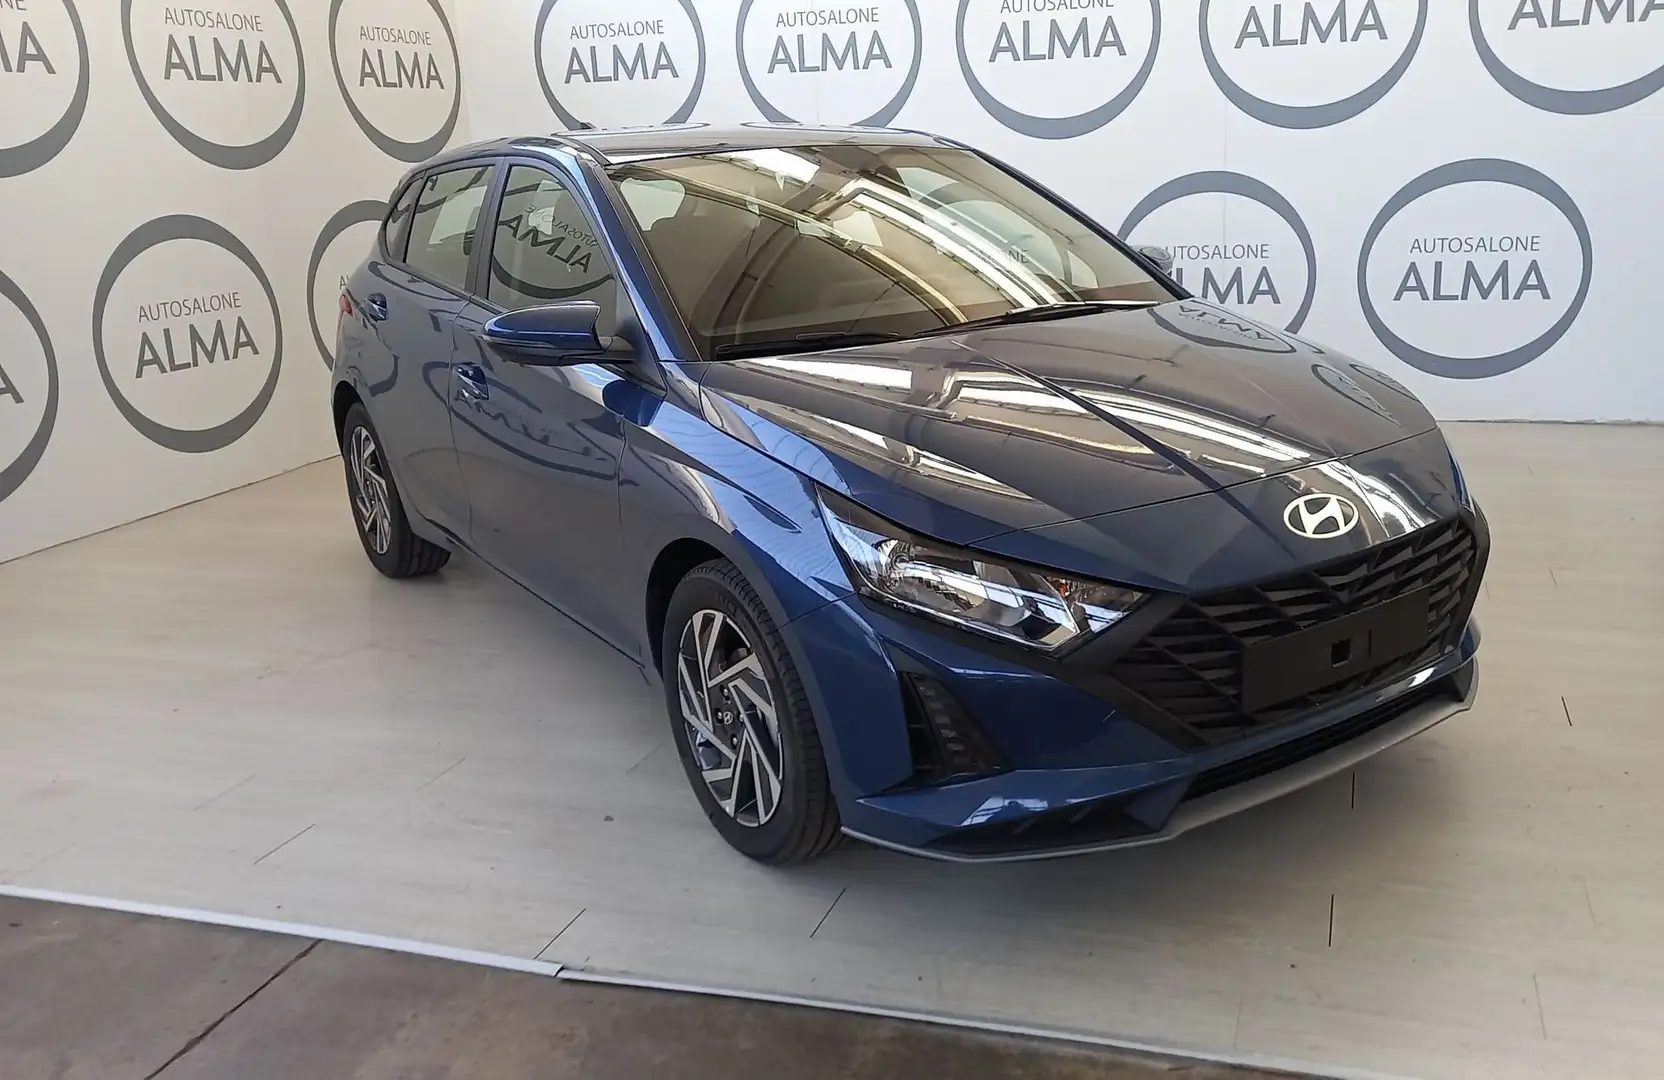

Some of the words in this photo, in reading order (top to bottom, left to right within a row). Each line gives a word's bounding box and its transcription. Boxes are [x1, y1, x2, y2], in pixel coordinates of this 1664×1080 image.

[164, 7, 264, 33] AUTOSALONE
[359, 25, 432, 46] AUTOSALONE
[569, 19, 665, 41] AUTOSALONE
[775, 6, 880, 28] AUTOSALONE
[1233, 0, 1389, 50] ALMA
[163, 33, 283, 84] ALMA
[767, 29, 893, 74] ALMA
[988, 15, 1128, 63] ALMA
[359, 47, 445, 90] ALMA
[564, 41, 680, 85] ALMA
[1165, 243, 1270, 261] UTOSALONE
[1409, 235, 1541, 254] AUTOSALONE
[1174, 265, 1282, 305] MA
[1392, 259, 1552, 302] ALMA
[138, 291, 242, 324] AUTOSALONE
[135, 315, 260, 379] ALMA
